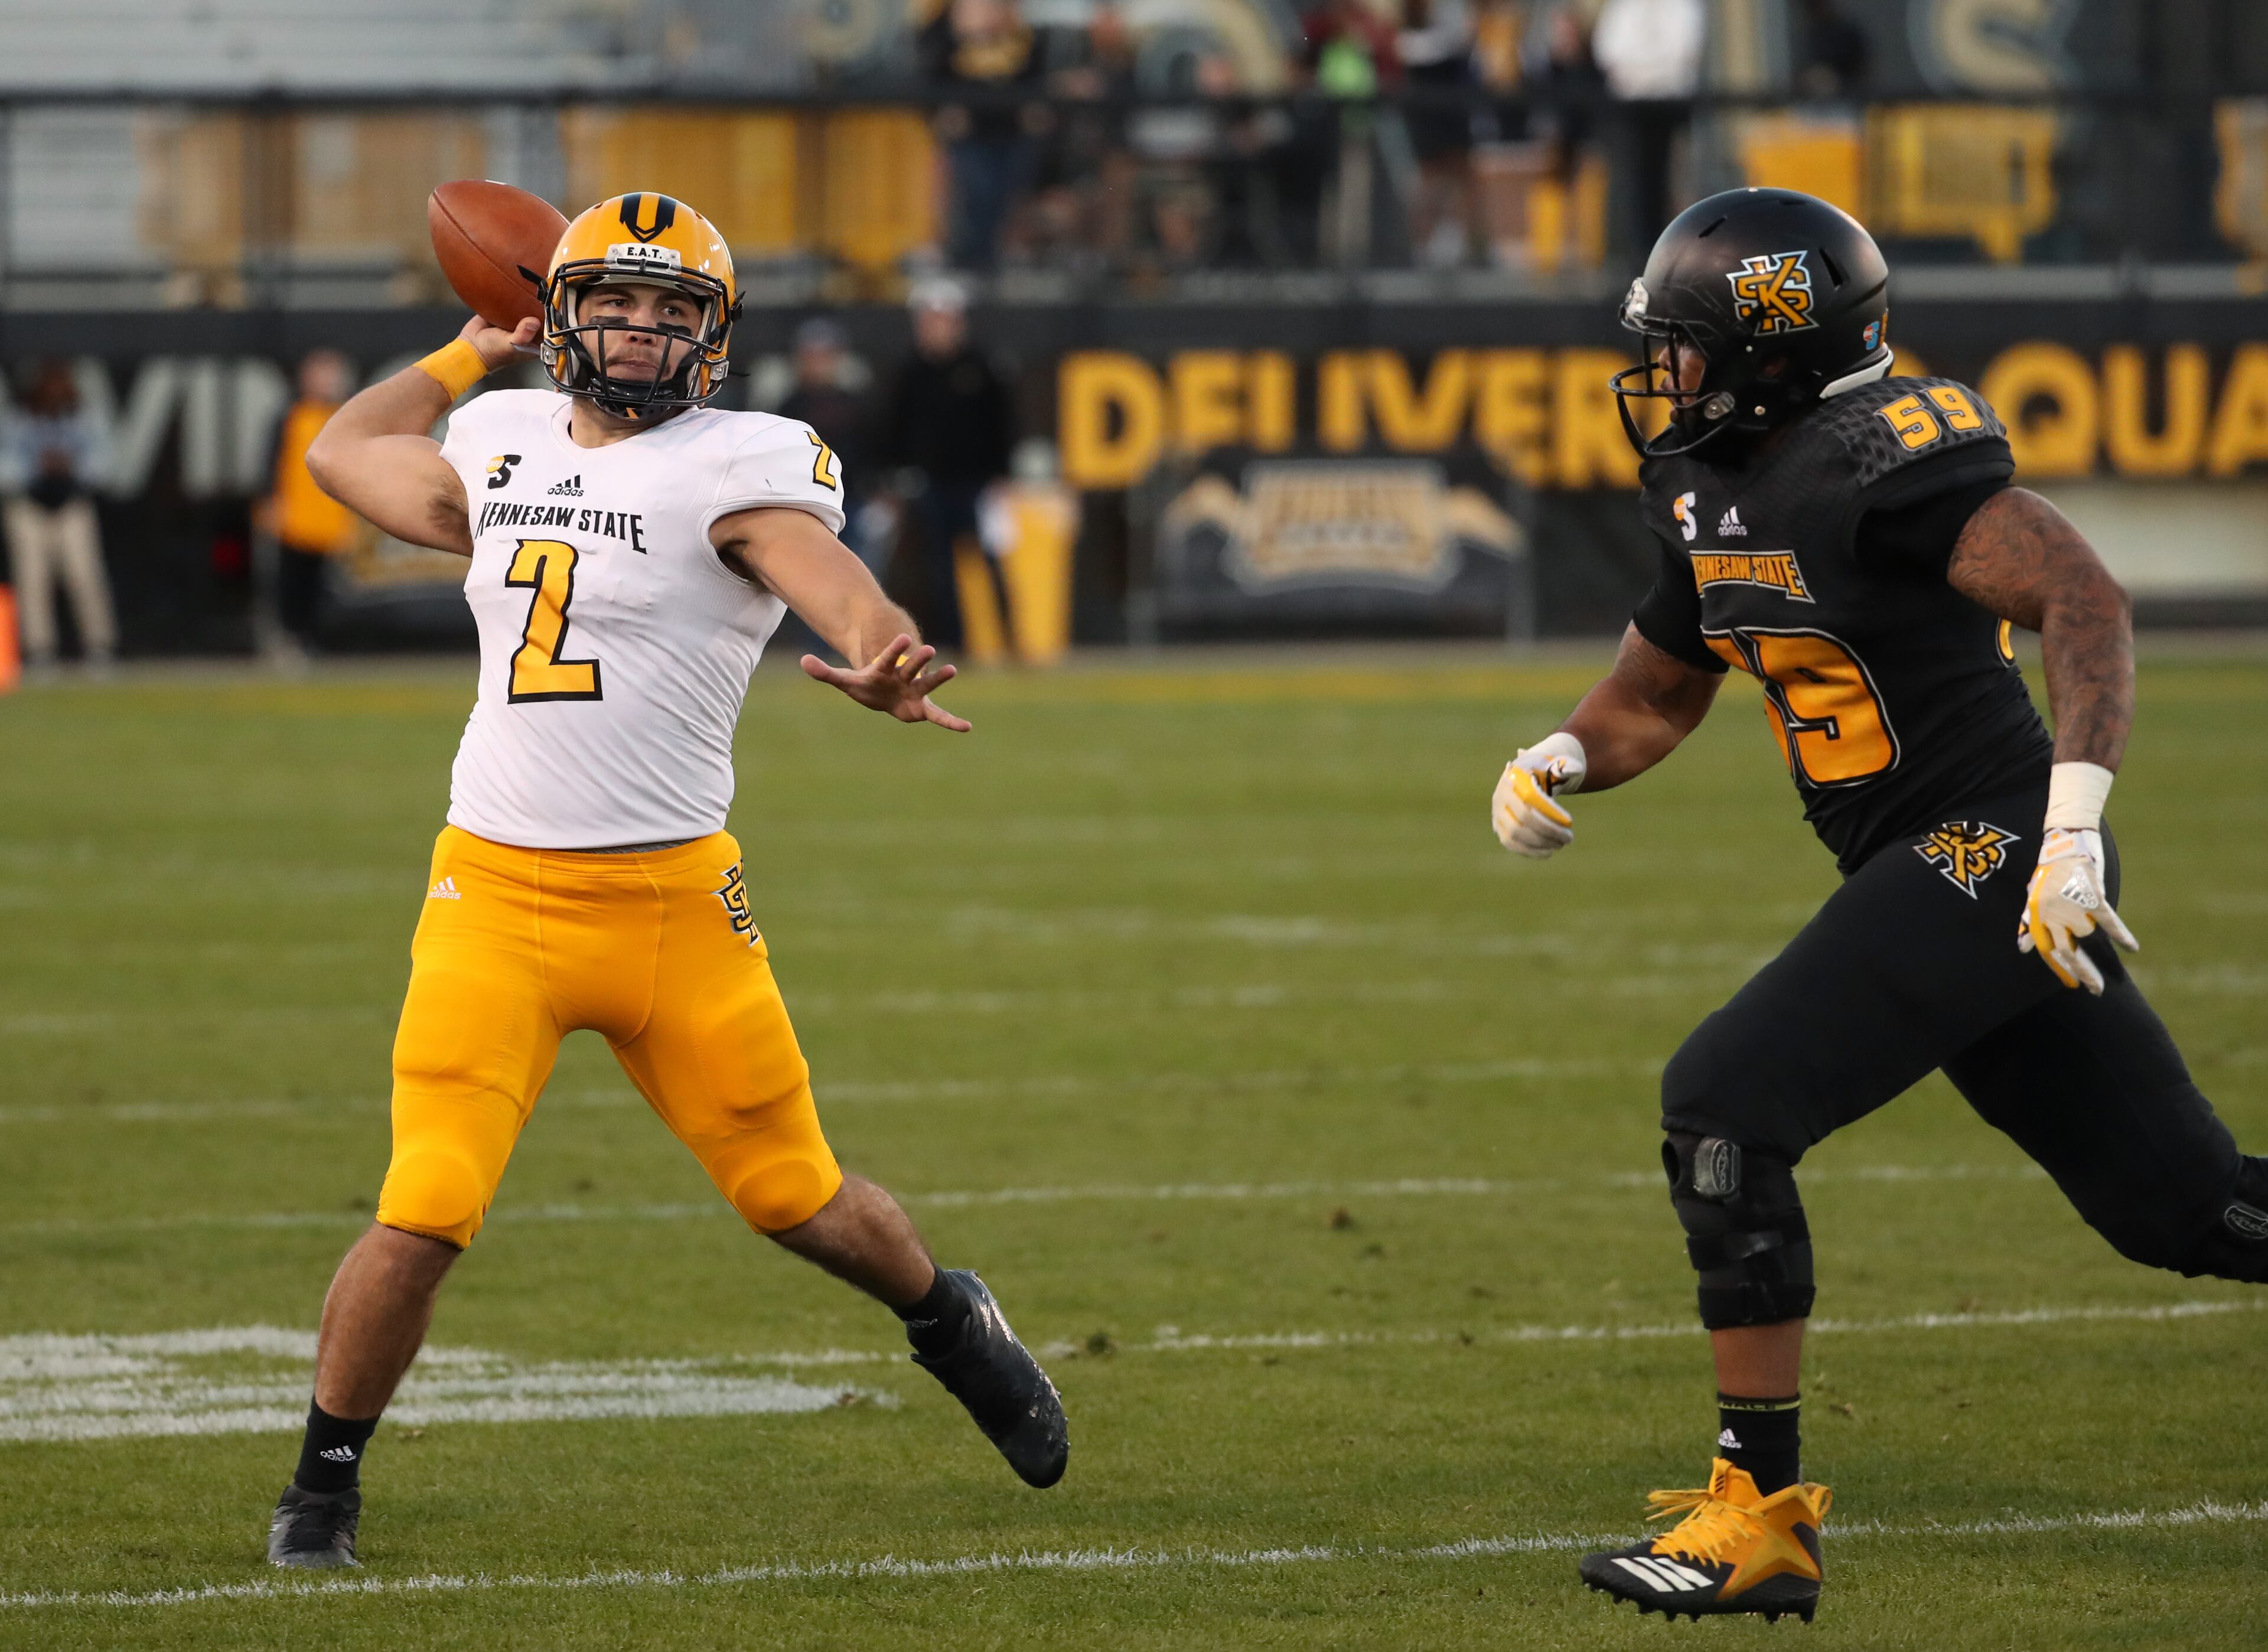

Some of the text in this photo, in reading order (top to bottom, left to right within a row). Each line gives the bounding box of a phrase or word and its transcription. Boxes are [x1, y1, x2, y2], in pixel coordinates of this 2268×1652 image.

[627, 247, 663, 259] E.A.T.
[1873, 386, 1984, 452] 59
[547, 486, 585, 497] adidas
[475, 502, 648, 555] KENNESAW STATE
[1718, 524, 1748, 536] adidas
[1752, 555, 1806, 597] STATE
[505, 539, 604, 705] 2
